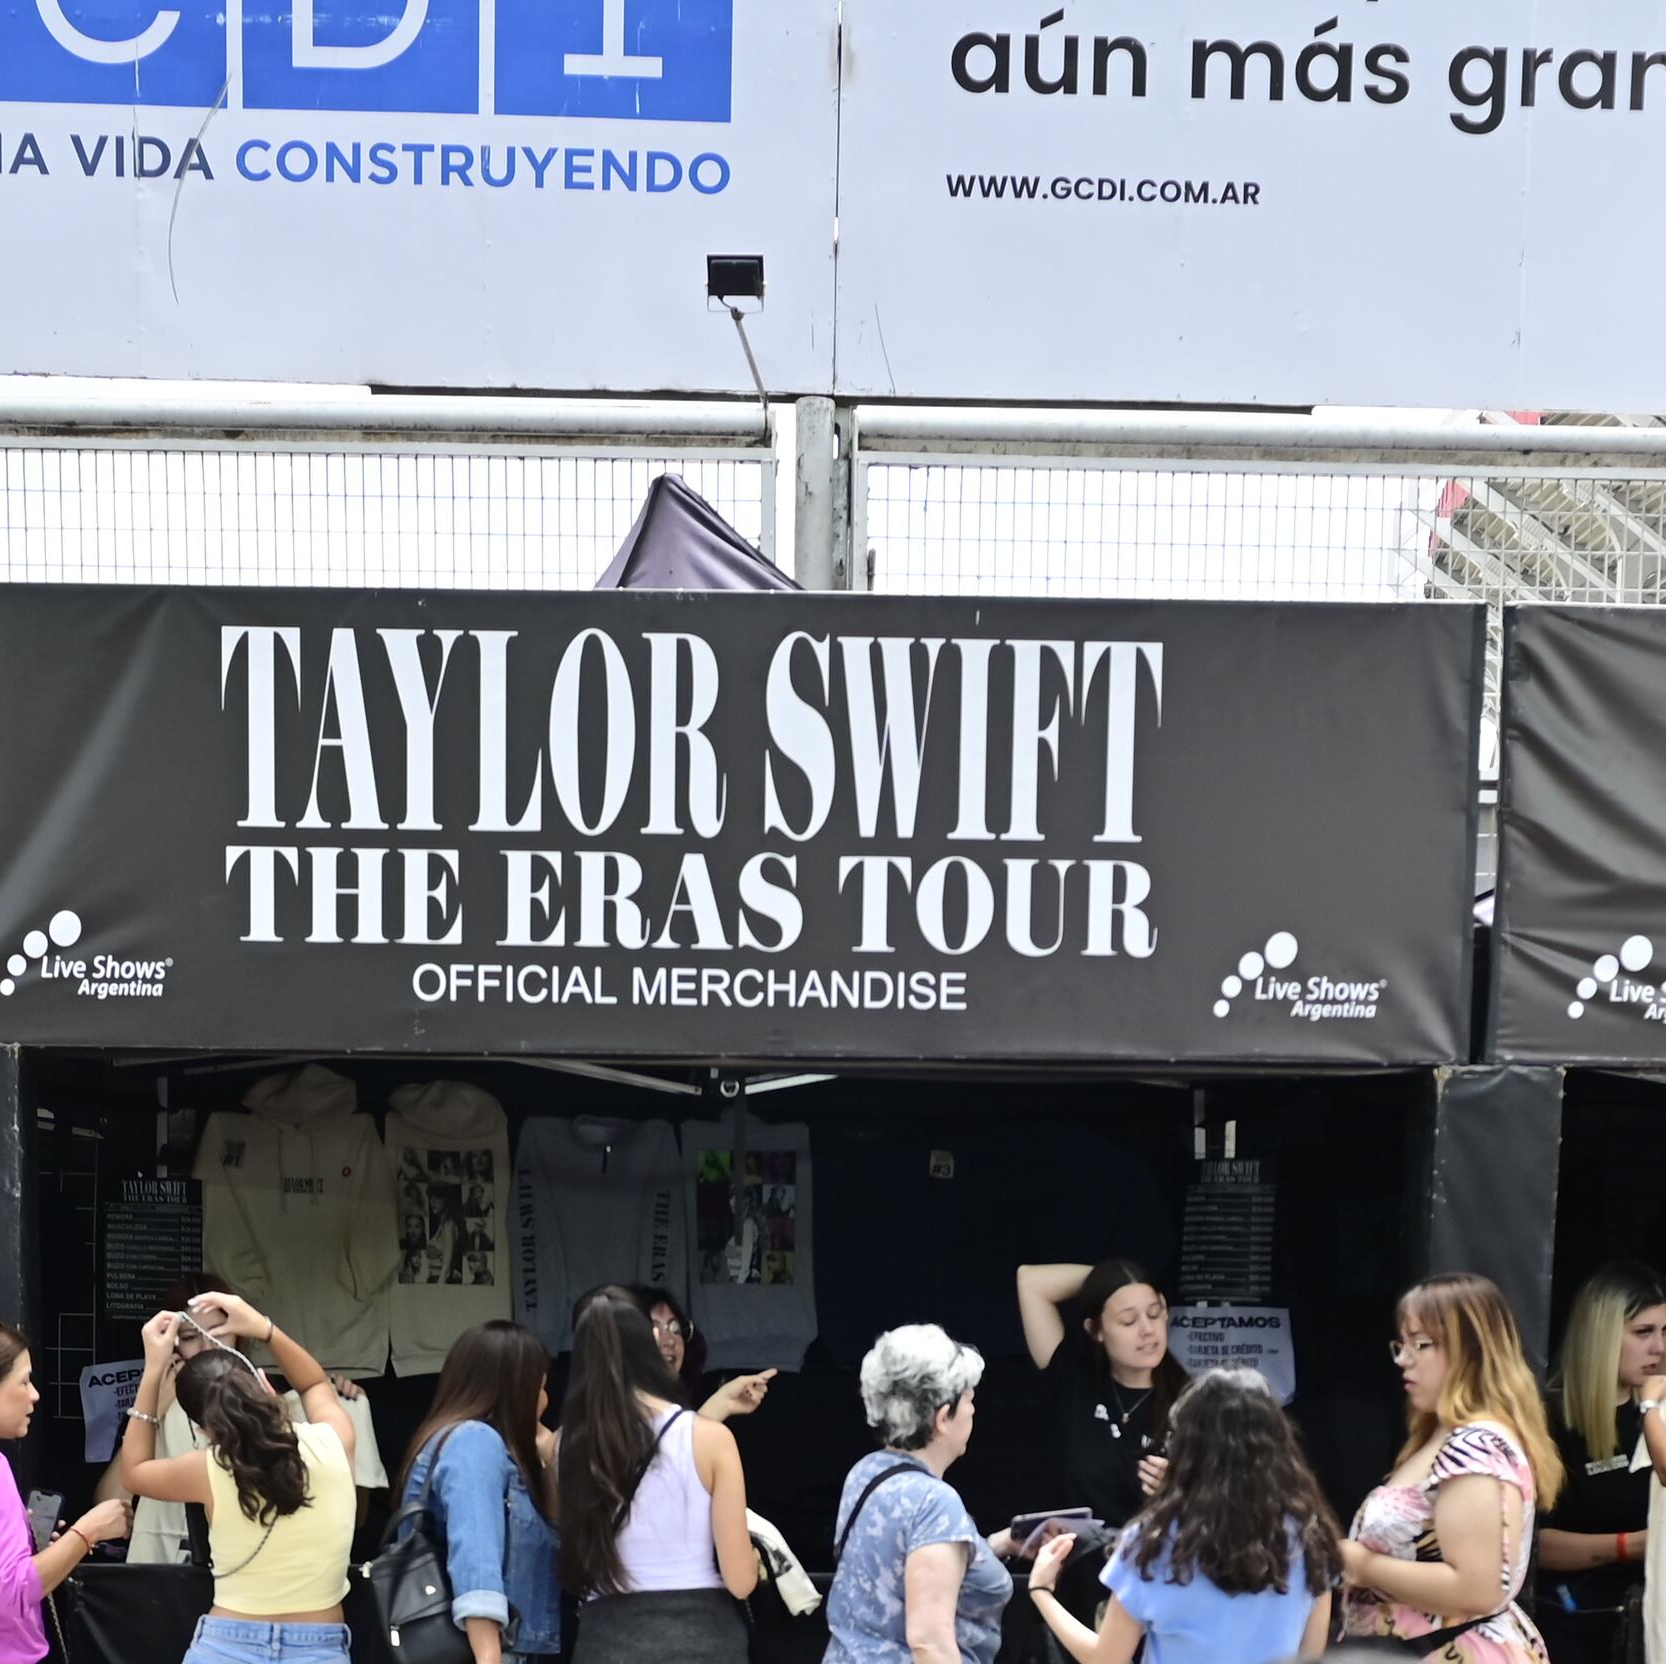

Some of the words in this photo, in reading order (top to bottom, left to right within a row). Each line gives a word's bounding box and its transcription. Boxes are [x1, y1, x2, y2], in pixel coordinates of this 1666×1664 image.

[951, 8, 1146, 97] aún
[1191, 16, 1409, 104] más
[70, 130, 214, 180] VIDA
[236, 140, 730, 194] CONSTRUYENDO
[946, 175, 1260, 204] WWW.GCDI.COM.AR
[222, 626, 726, 838] TAYLOR
[765, 631, 1163, 842] SWIFT
[226, 846, 462, 944] THE
[496, 851, 802, 952] ERAS
[839, 856, 1157, 958] TOUR
[41, 956, 86, 978] Live
[75, 975, 165, 999] Argentina
[413, 963, 617, 1004] OFFICIAL
[633, 967, 966, 1010] MERCHANDISE
[1255, 977, 1300, 1000] Live
[1609, 981, 1654, 1003] Live
[1289, 998, 1377, 1021] Argentina
[160, 1181, 188, 1196] SWIFT
[654, 1189, 671, 1229] THE
[521, 1234, 538, 1312] TAYLOR
[651, 1234, 668, 1282] ERAS
[1171, 1316, 1281, 1329] ACEPTAMOS
